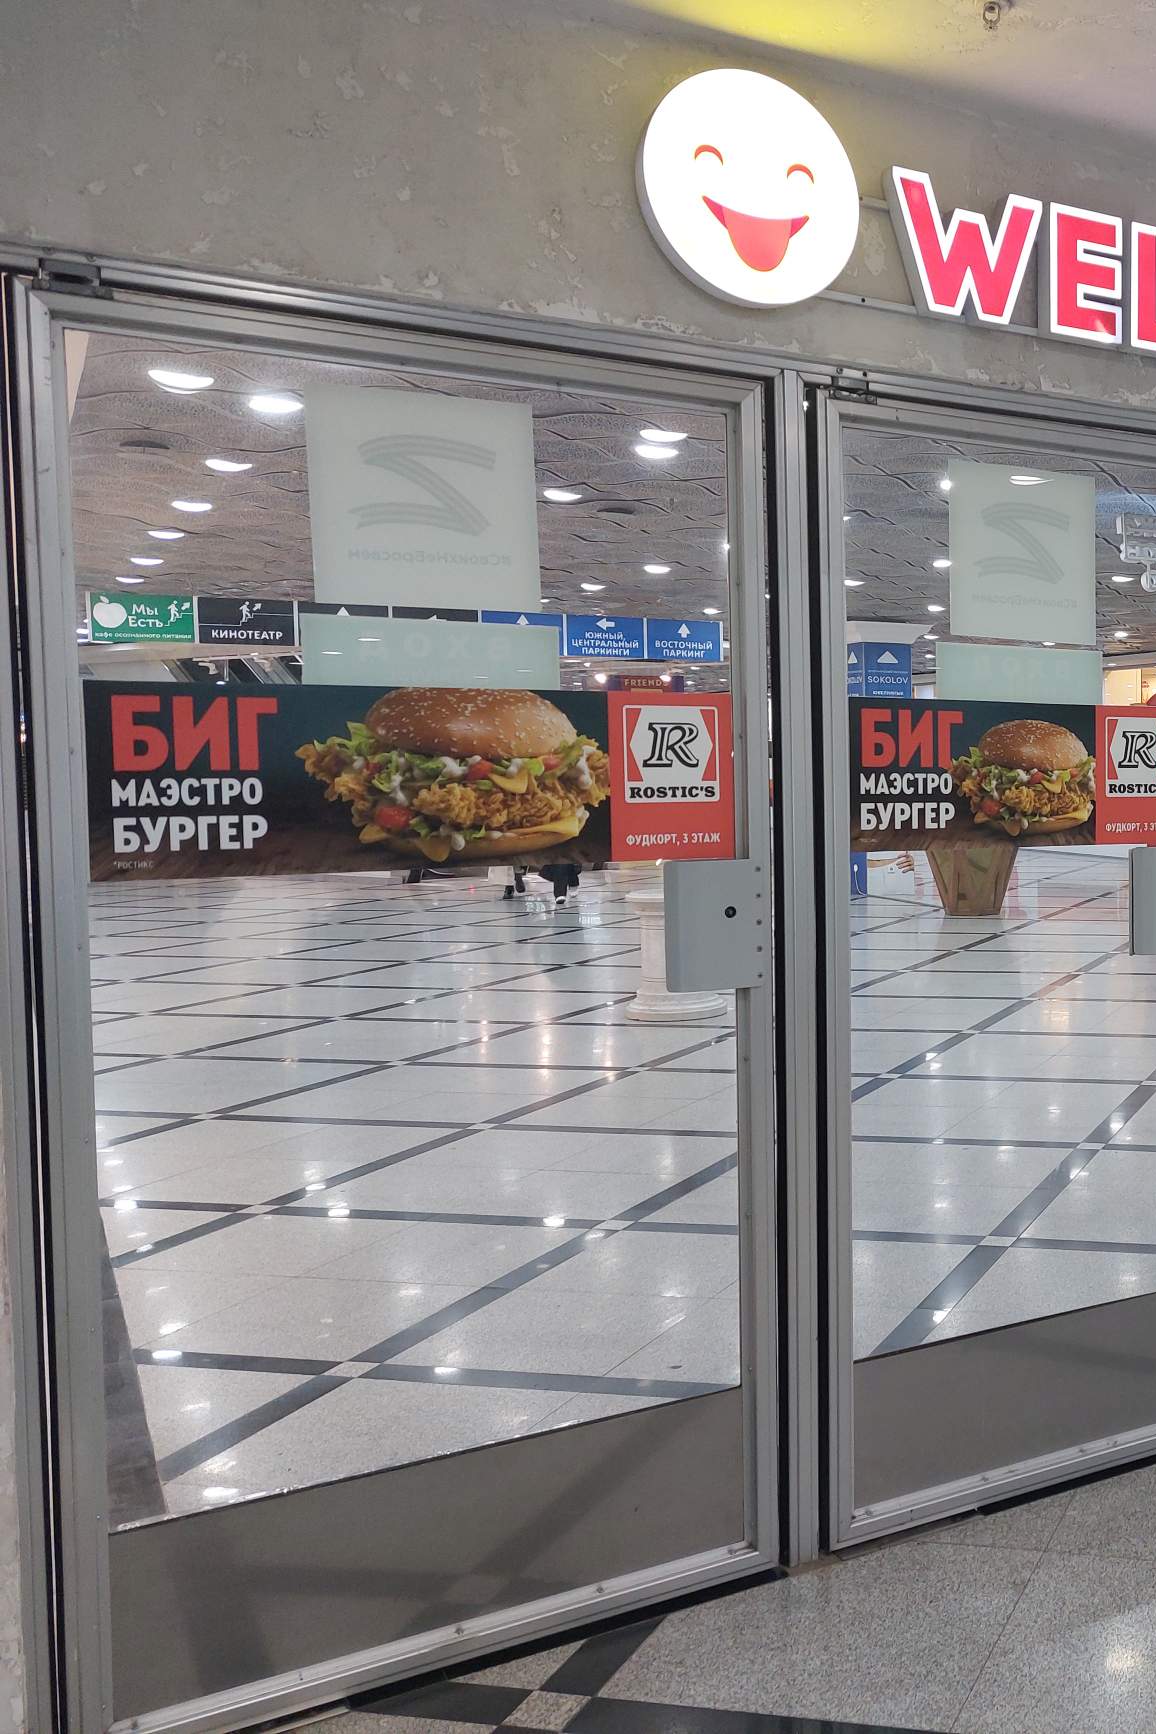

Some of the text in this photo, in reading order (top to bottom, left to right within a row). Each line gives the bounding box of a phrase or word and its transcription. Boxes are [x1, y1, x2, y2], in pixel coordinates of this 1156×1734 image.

[132, 604, 158, 615] Мы
[128, 616, 164, 628] Есть
[211, 629, 283, 640] КИНОТЕАТР
[572, 638, 639, 649] ЦЕНТРАЛЬНЫЙ
[655, 640, 713, 650] ВОСТОЧНЫЙ
[582, 648, 630, 656] ПАРКИНГИ
[663, 650, 705, 658] ПАРКИНГ
[867, 675, 908, 684] SOKOLOV
[111, 695, 277, 771] БИГ
[861, 708, 963, 768] БИГ
[860, 772, 953, 795] МАЭСТРО
[111, 777, 264, 807] МАЭСТРО
[629, 786, 716, 798] ROSTIC'S
[860, 802, 956, 830] БУРГЕР
[1105, 822, 1142, 833] ФУДКОРТ,
[113, 815, 268, 853] БУРГЕР
[626, 833, 680, 846] ФУДКОРТ,
[691, 832, 720, 843] ЭТАЖ
